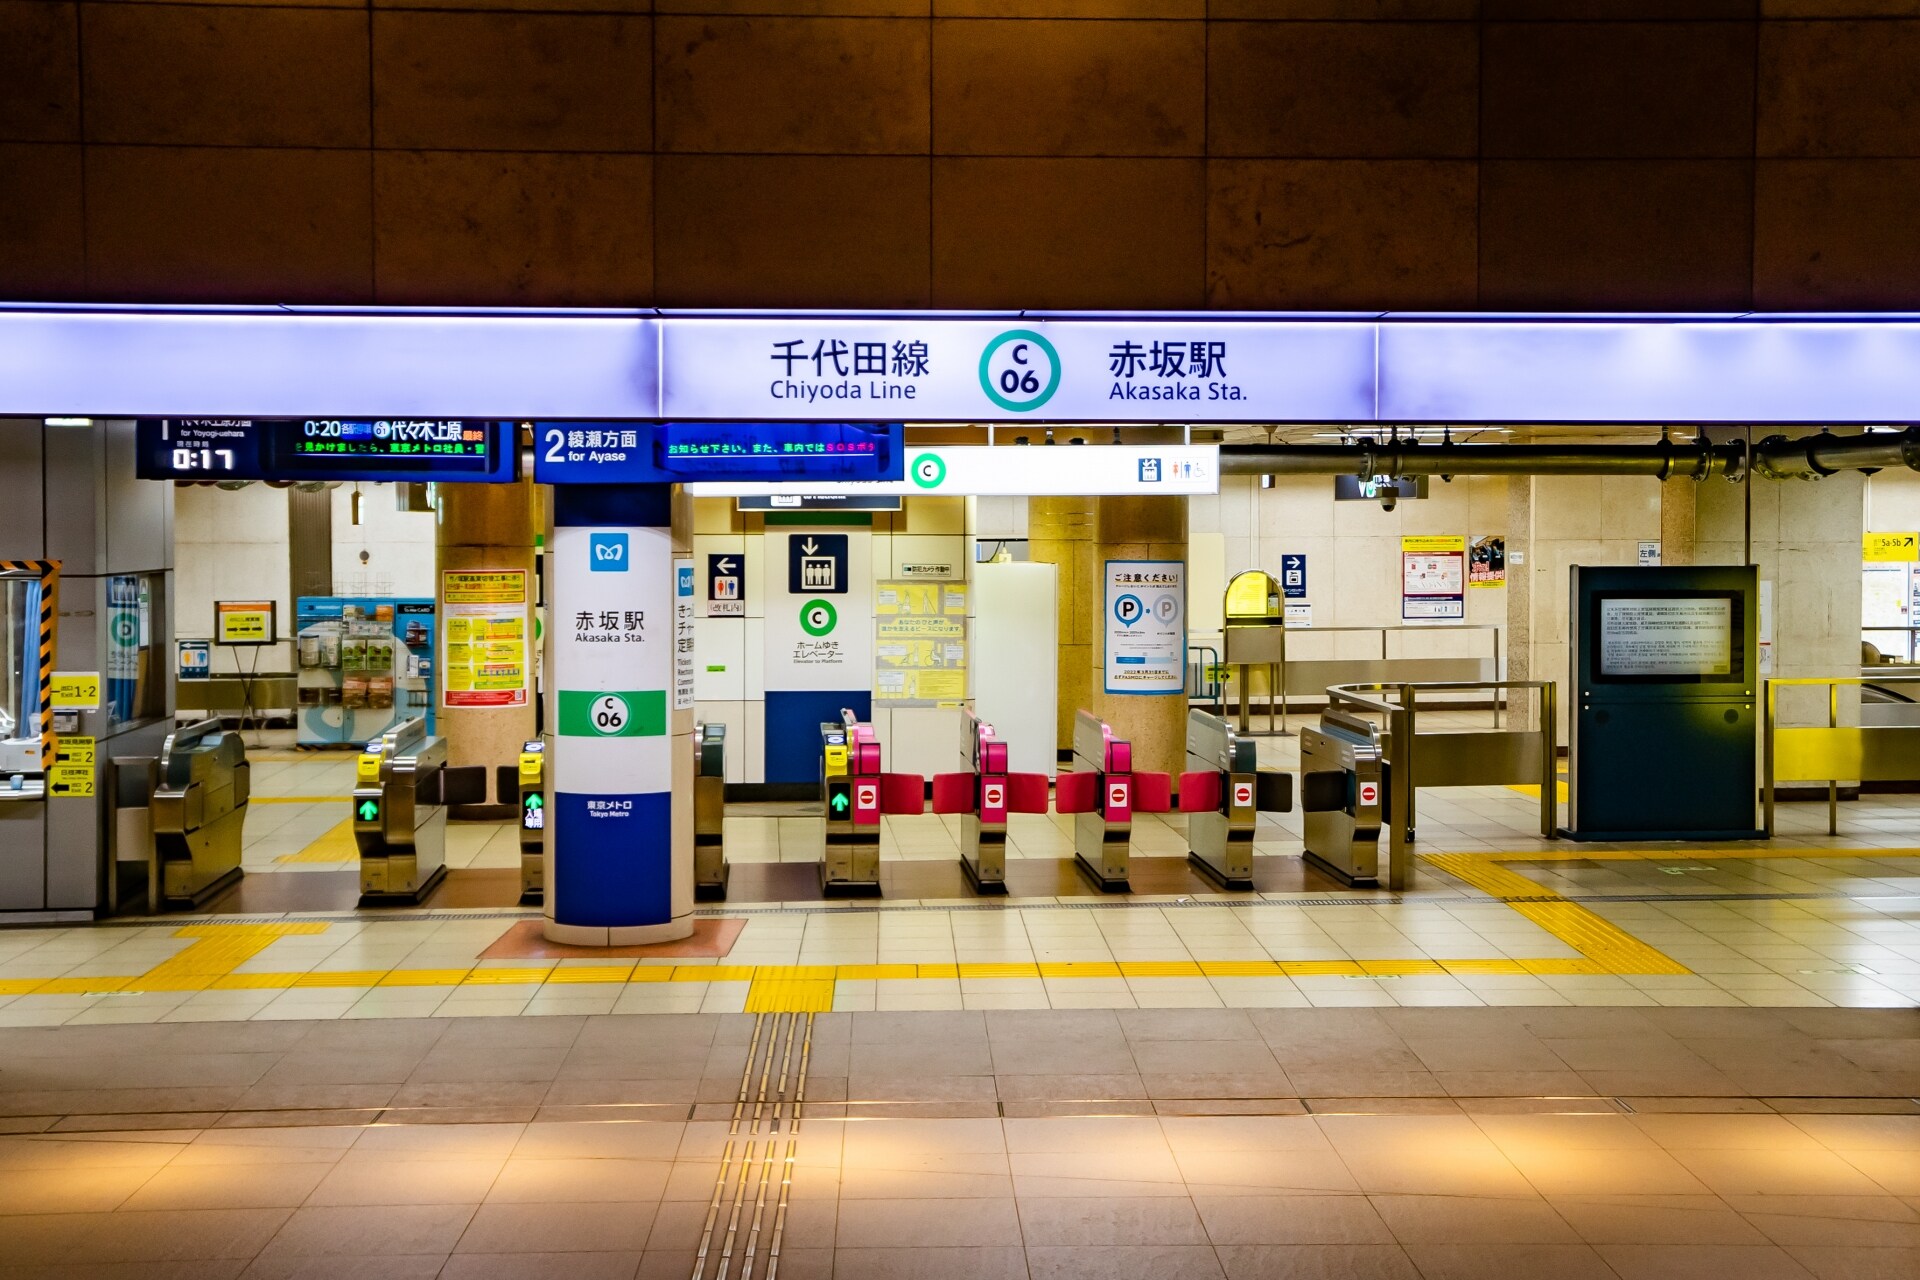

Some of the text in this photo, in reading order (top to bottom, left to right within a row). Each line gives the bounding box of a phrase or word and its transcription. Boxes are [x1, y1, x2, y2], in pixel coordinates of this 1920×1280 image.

[769, 338, 930, 379] 千代田線
[1011, 343, 1029, 366] C
[1108, 339, 1228, 379] 赤坂駅
[999, 368, 1040, 394] 06
[770, 379, 917, 403] Chiyoda Line
[1108, 381, 1249, 401] Akasaka Sta.
[180, 429, 246, 439] for Yoyogi-uehara
[304, 420, 340, 437] 0:20
[390, 420, 462, 441] 代々木上原
[462, 430, 484, 442] 最終
[544, 429, 566, 463] 2
[567, 430, 638, 449] 綾瀬方面
[172, 448, 234, 470] 0:17
[567, 450, 627, 464] for Ayase
[922, 464, 932, 477] C
[1122, 601, 1135, 618] P
[1161, 601, 1172, 618] P
[575, 610, 645, 631] 赤坂駅
[811, 611, 822, 625] C
[574, 632, 646, 643] Akasaka Sta.
[796, 641, 840, 650] ホームゆき
[792, 650, 844, 659] エレベーター
[604, 697, 614, 710] C
[596, 712, 622, 728] 06
[85, 751, 93, 763] 2
[85, 781, 93, 794] 2
[586, 800, 633, 810] 東京メトロ
[589, 810, 630, 819] Tokyo Metro
